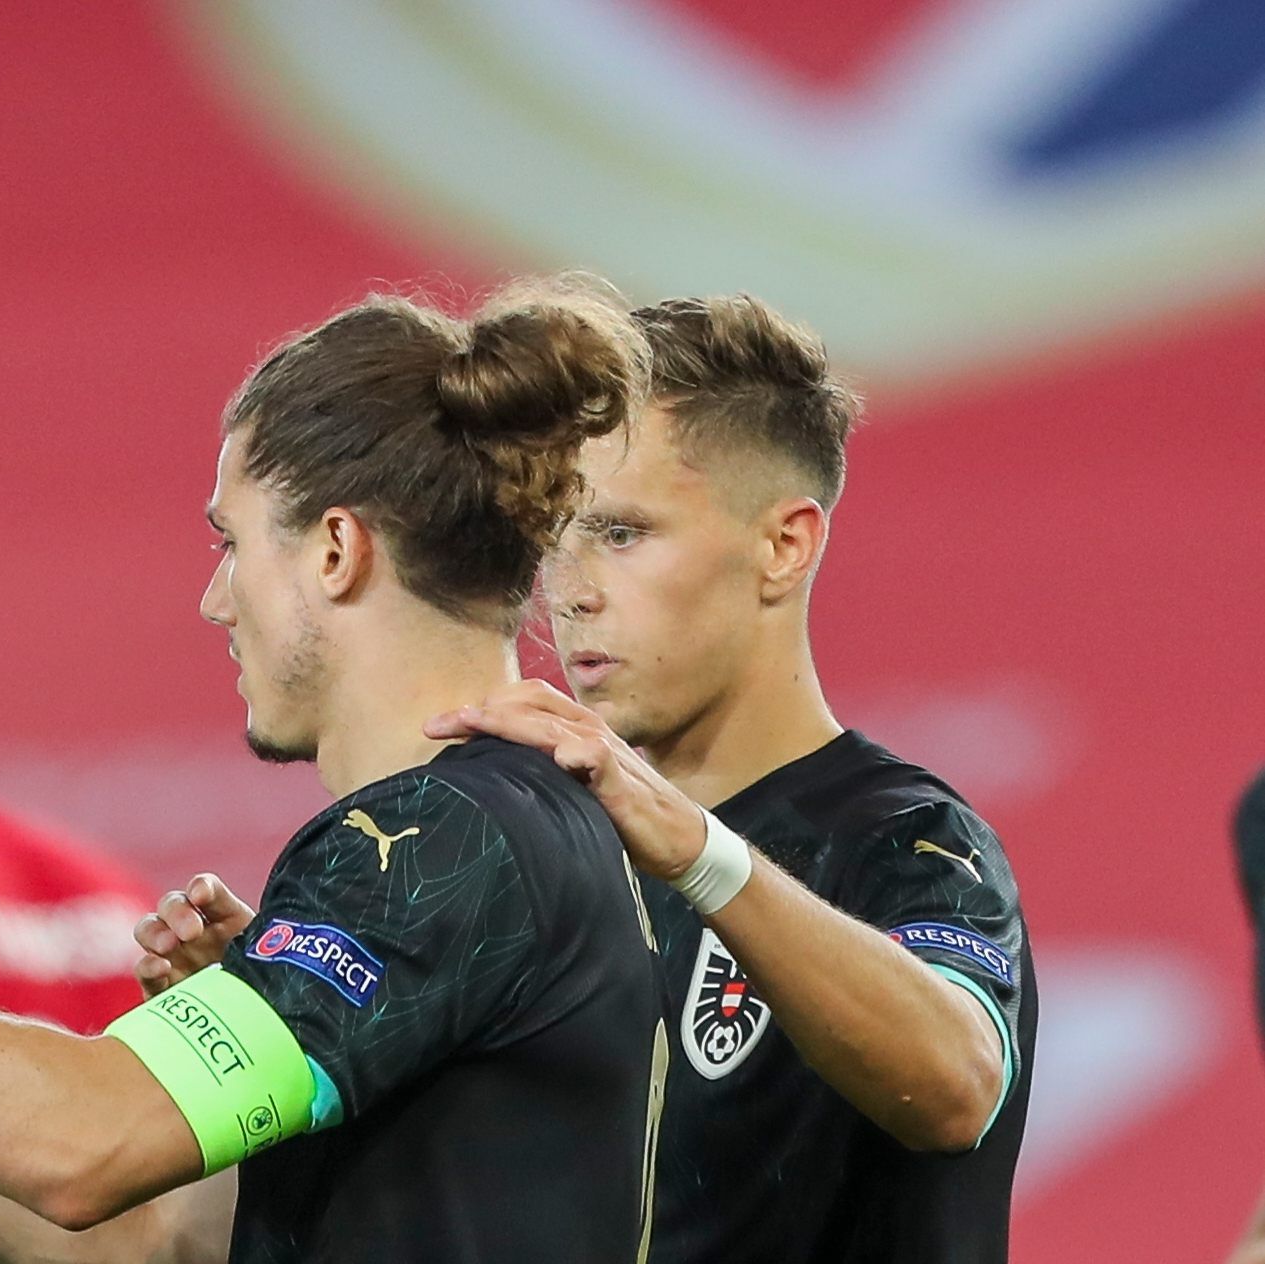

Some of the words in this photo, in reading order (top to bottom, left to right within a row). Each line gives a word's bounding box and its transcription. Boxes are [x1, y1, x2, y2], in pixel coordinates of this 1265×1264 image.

[284, 934, 378, 994] RESPECT
[906, 929, 1010, 974] RESPECT
[156, 994, 246, 1076] RESPECT
